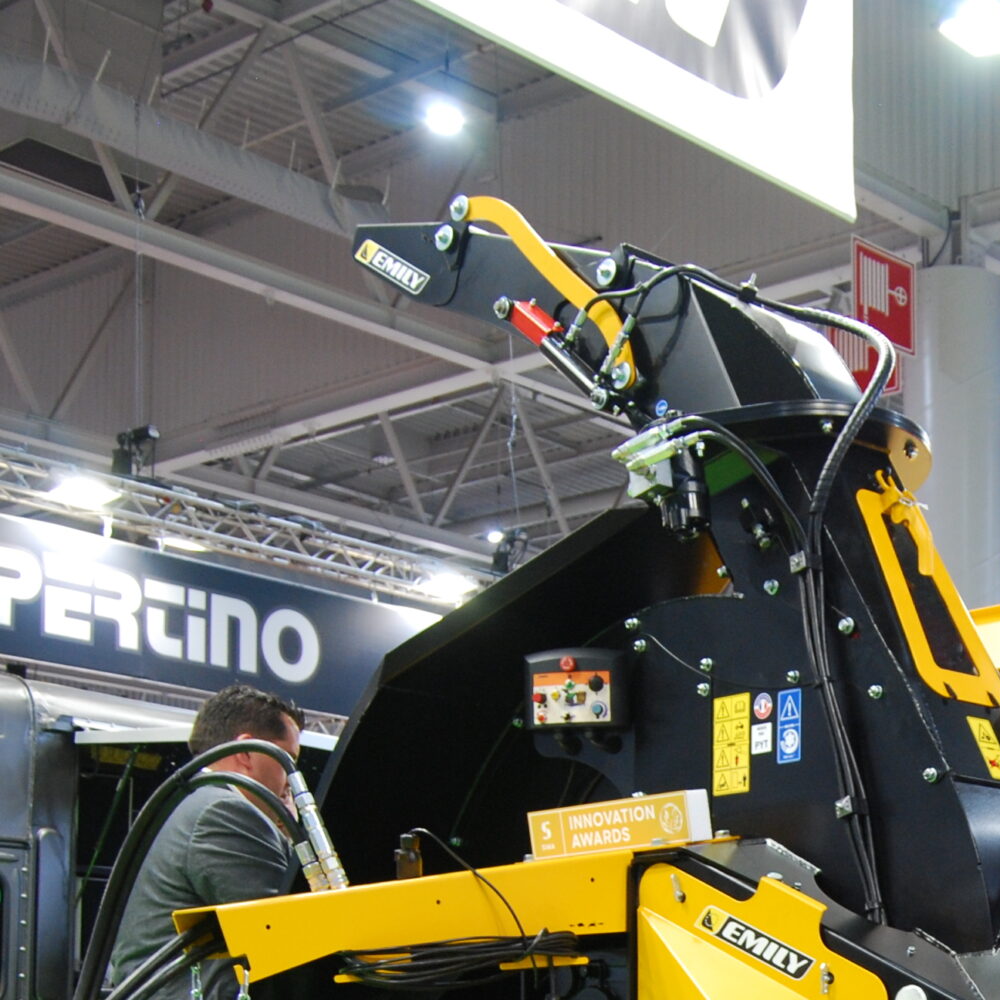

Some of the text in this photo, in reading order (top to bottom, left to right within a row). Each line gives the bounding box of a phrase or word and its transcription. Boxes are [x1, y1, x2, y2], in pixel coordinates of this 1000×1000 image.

[371, 250, 426, 290] EMILY
[568, 804, 656, 831] INNOVATION
[571, 827, 631, 849] AWARDS
[721, 920, 810, 975] EMILY
